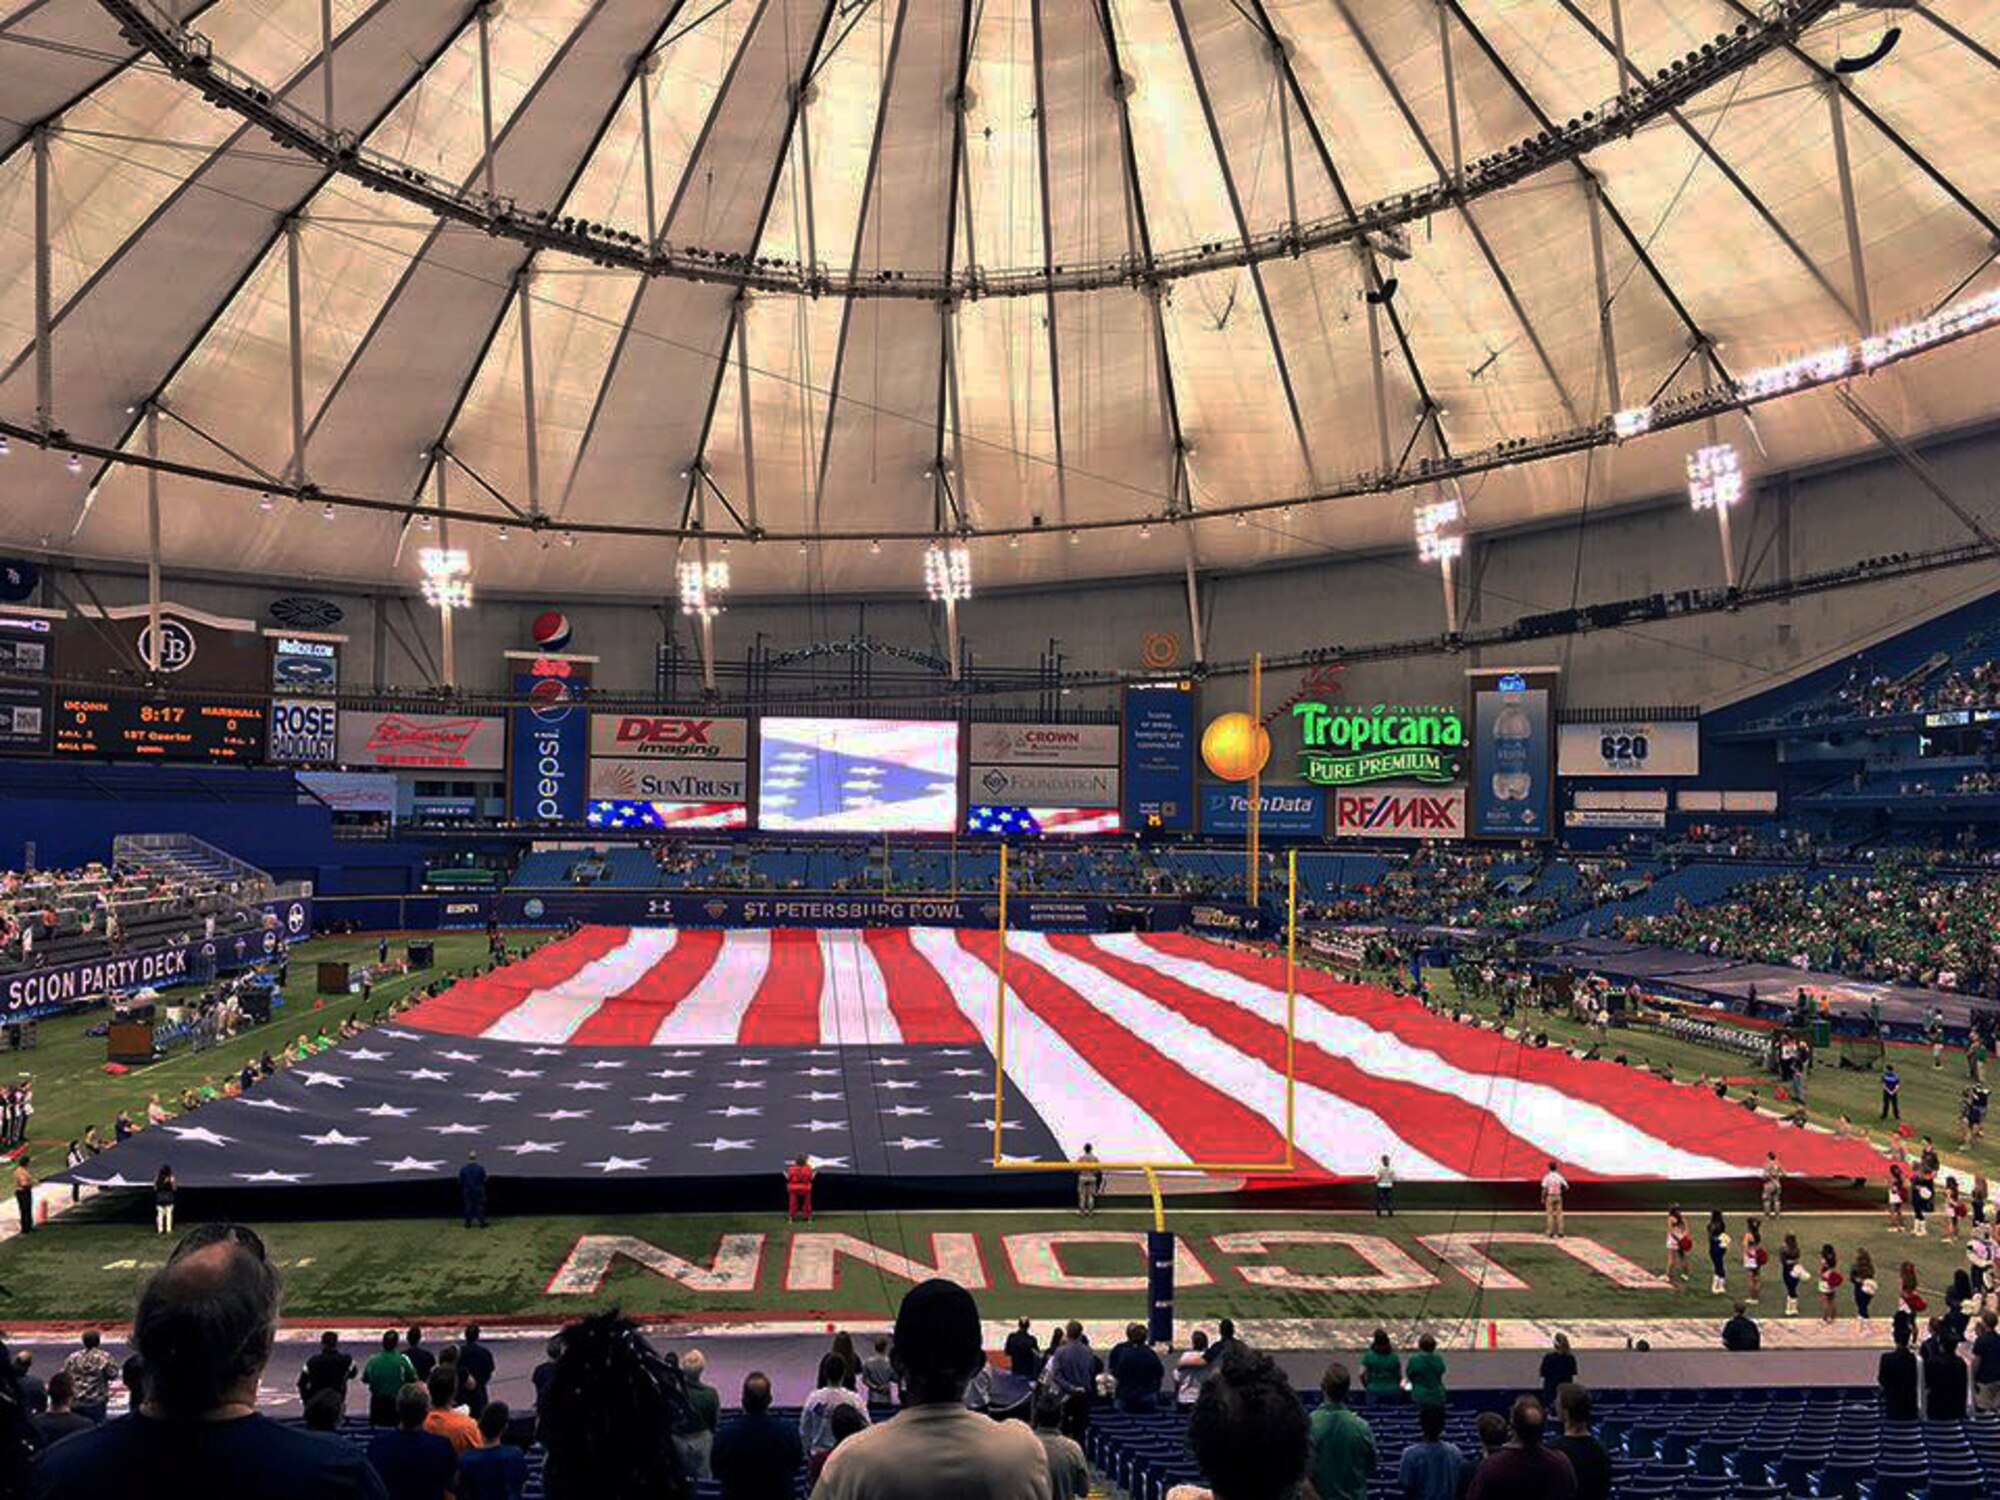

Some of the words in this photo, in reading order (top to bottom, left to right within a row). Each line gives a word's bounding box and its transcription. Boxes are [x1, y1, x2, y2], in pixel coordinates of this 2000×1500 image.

[64, 701, 109, 711] UCONN
[141, 706, 185, 722] 8:17
[201, 707, 262, 719] MARSHALL
[76, 711, 87, 724] 0
[226, 718, 237, 731] 0
[272, 706, 335, 735] ROSE
[1293, 702, 1462, 751] Tropicana
[123, 730, 145, 740] 1ST
[148, 731, 192, 742] Quarter
[616, 718, 714, 743] DEX
[1025, 731, 1080, 743] CROWN
[1601, 735, 1648, 760] 620
[536, 728, 566, 820] pepsi
[1310, 760, 1356, 779] PURE
[1359, 754, 1441, 775] PREMIUM
[1337, 795, 1457, 830] RE/MAX
[744, 901, 770, 920] ST.
[775, 901, 904, 919] PETERSBURG
[909, 902, 965, 919] BOWL
[8, 970, 75, 1011] SCION
[80, 956, 140, 995] PARTY
[142, 949, 188, 982] DECK
